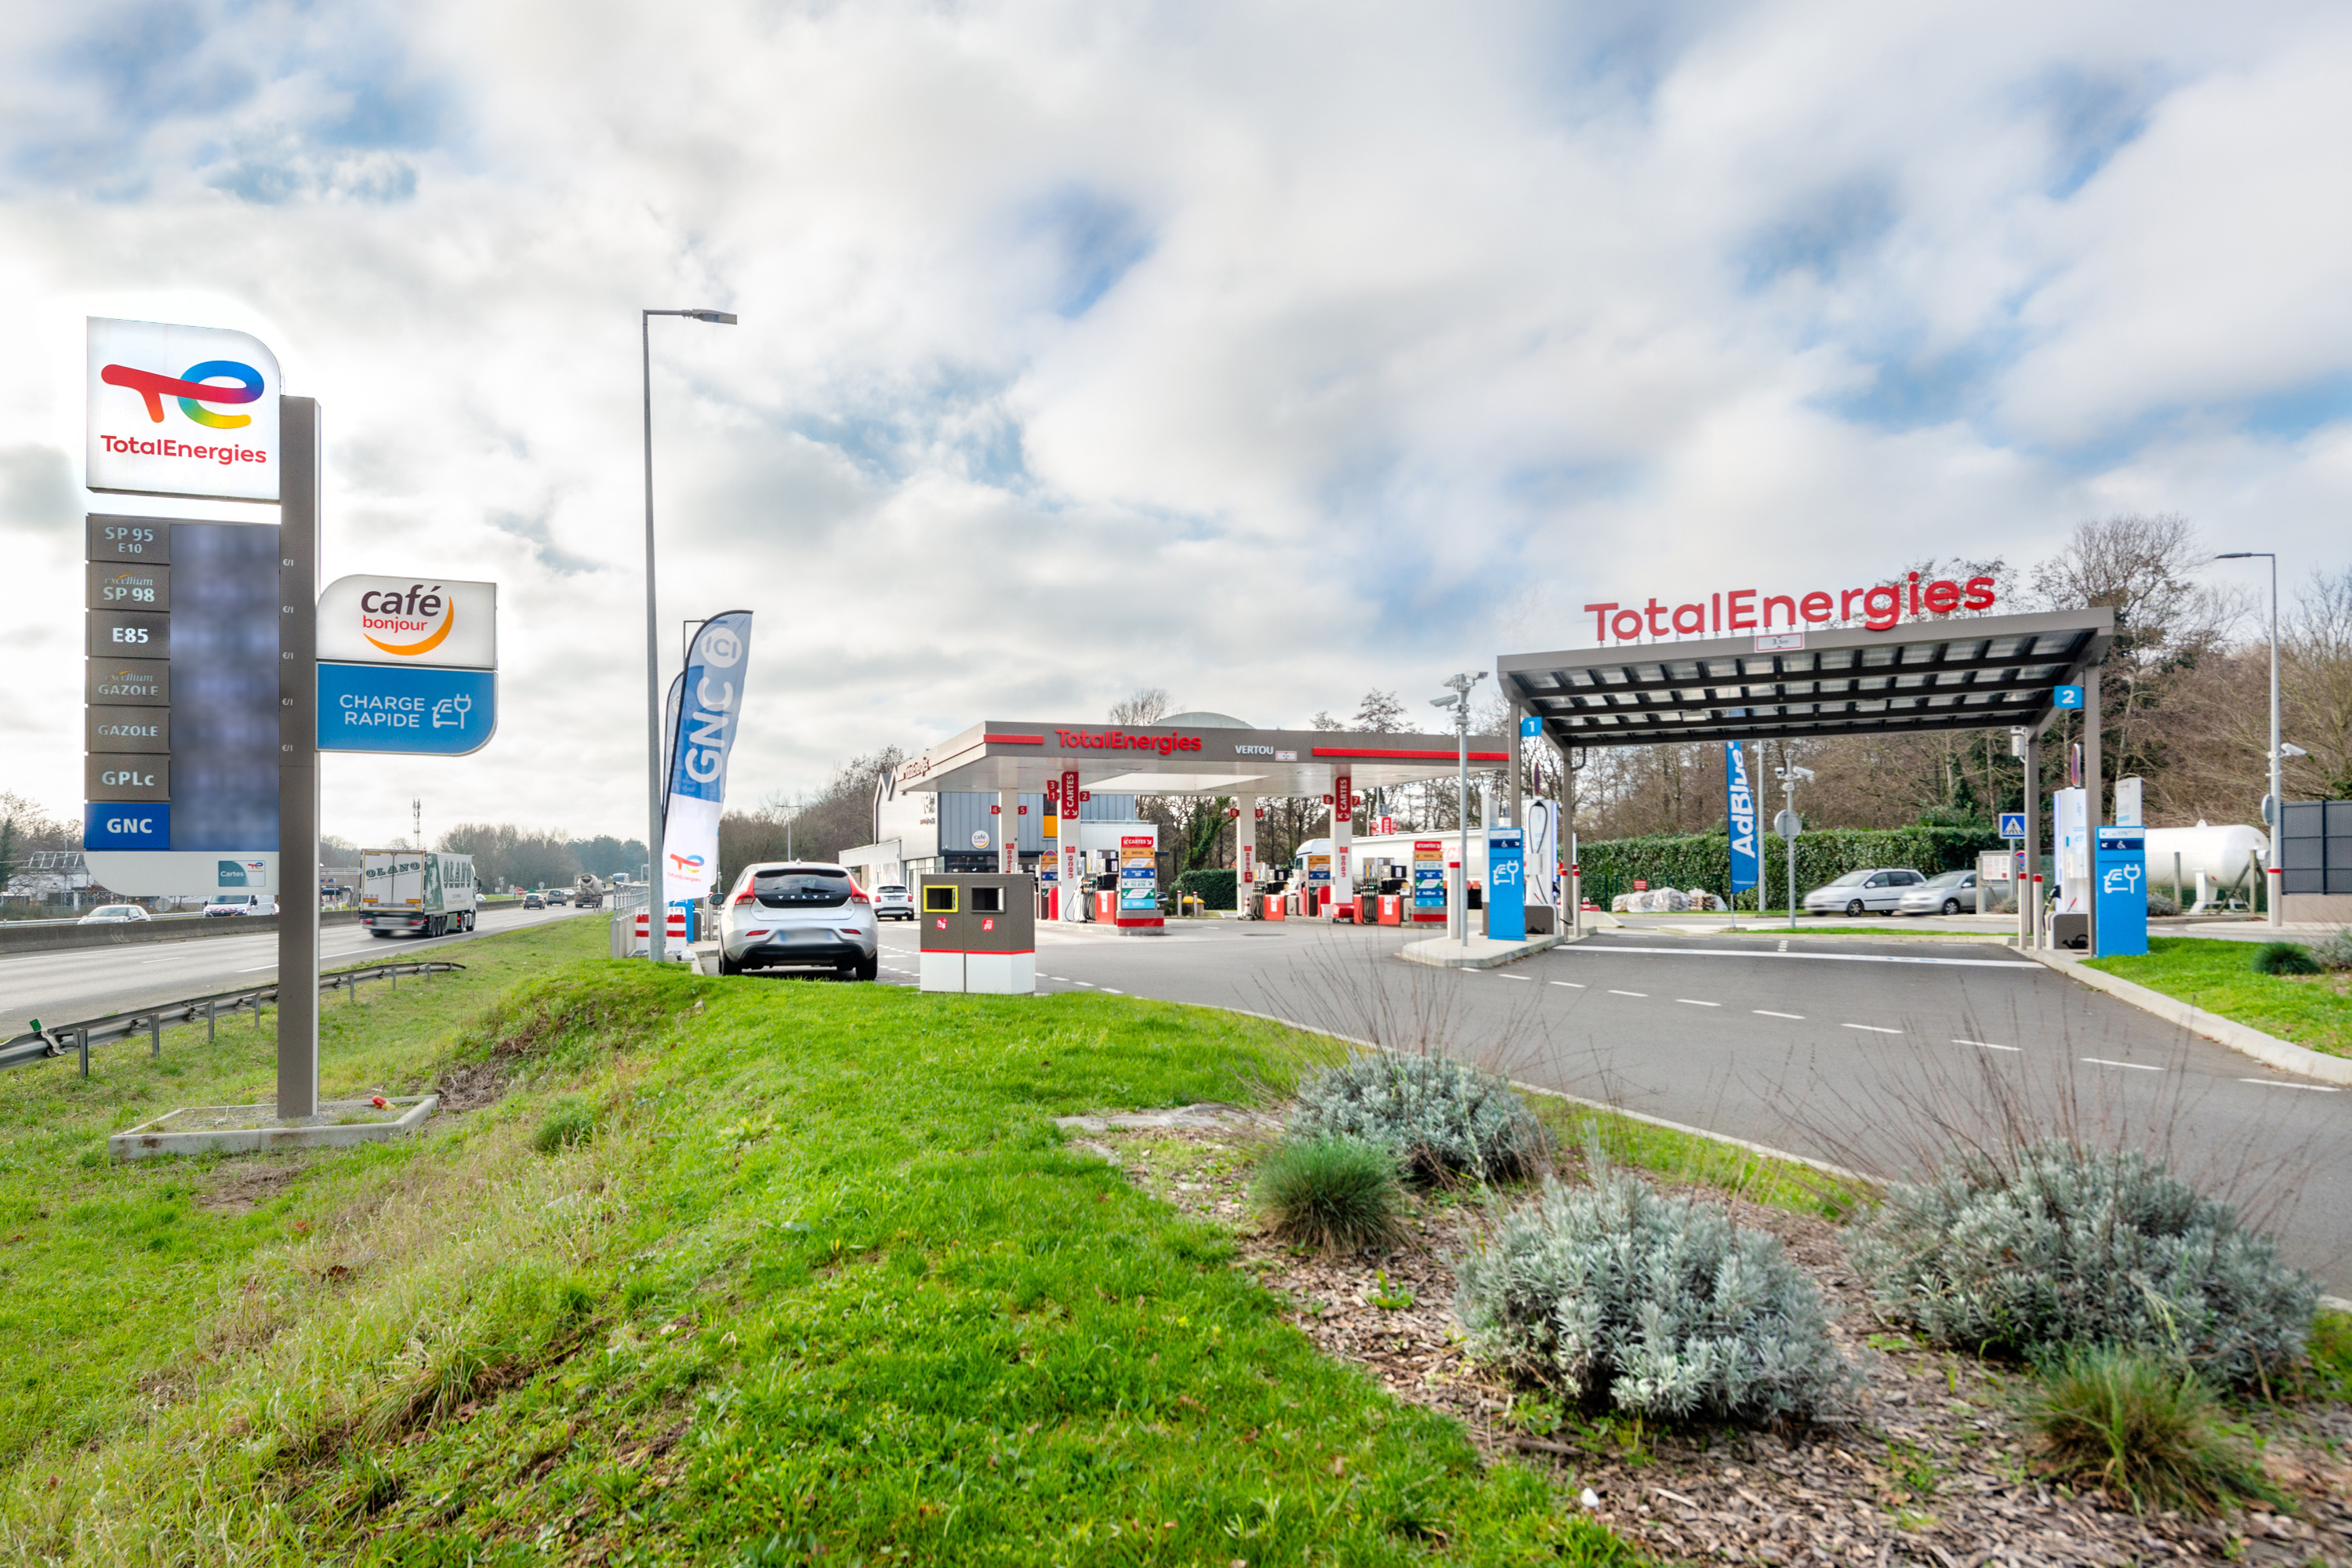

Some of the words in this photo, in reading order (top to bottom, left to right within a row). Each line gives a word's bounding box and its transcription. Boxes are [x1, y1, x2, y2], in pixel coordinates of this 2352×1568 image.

[100, 434, 267, 466] TotalEnergies
[104, 527, 128, 539] SP
[132, 528, 154, 542] 95
[118, 543, 142, 554] E10
[104, 575, 154, 586] excellium
[103, 586, 127, 601] SP
[132, 588, 154, 602] 98
[361, 584, 441, 616] café
[1584, 571, 1995, 641] TotalEnergies
[363, 615, 428, 633] bonjour
[112, 627, 149, 644] E85
[705, 636, 738, 659] ICI
[104, 672, 154, 682] excellium
[98, 684, 158, 696] GAZOLE
[2062, 689, 2074, 704] 2
[339, 695, 425, 711] CHARGE
[345, 711, 420, 728] RAPIDE
[1528, 720, 1535, 732] 1
[98, 724, 158, 737] GAZOLE
[684, 677, 734, 783] GNC
[1055, 729, 1202, 755] TotalEnergies
[1235, 745, 1274, 755] VERTOU
[101, 771, 154, 786] GPLc
[107, 818, 152, 833] GNC
[366, 862, 420, 877] OLANO
[443, 859, 471, 888] OLANO
